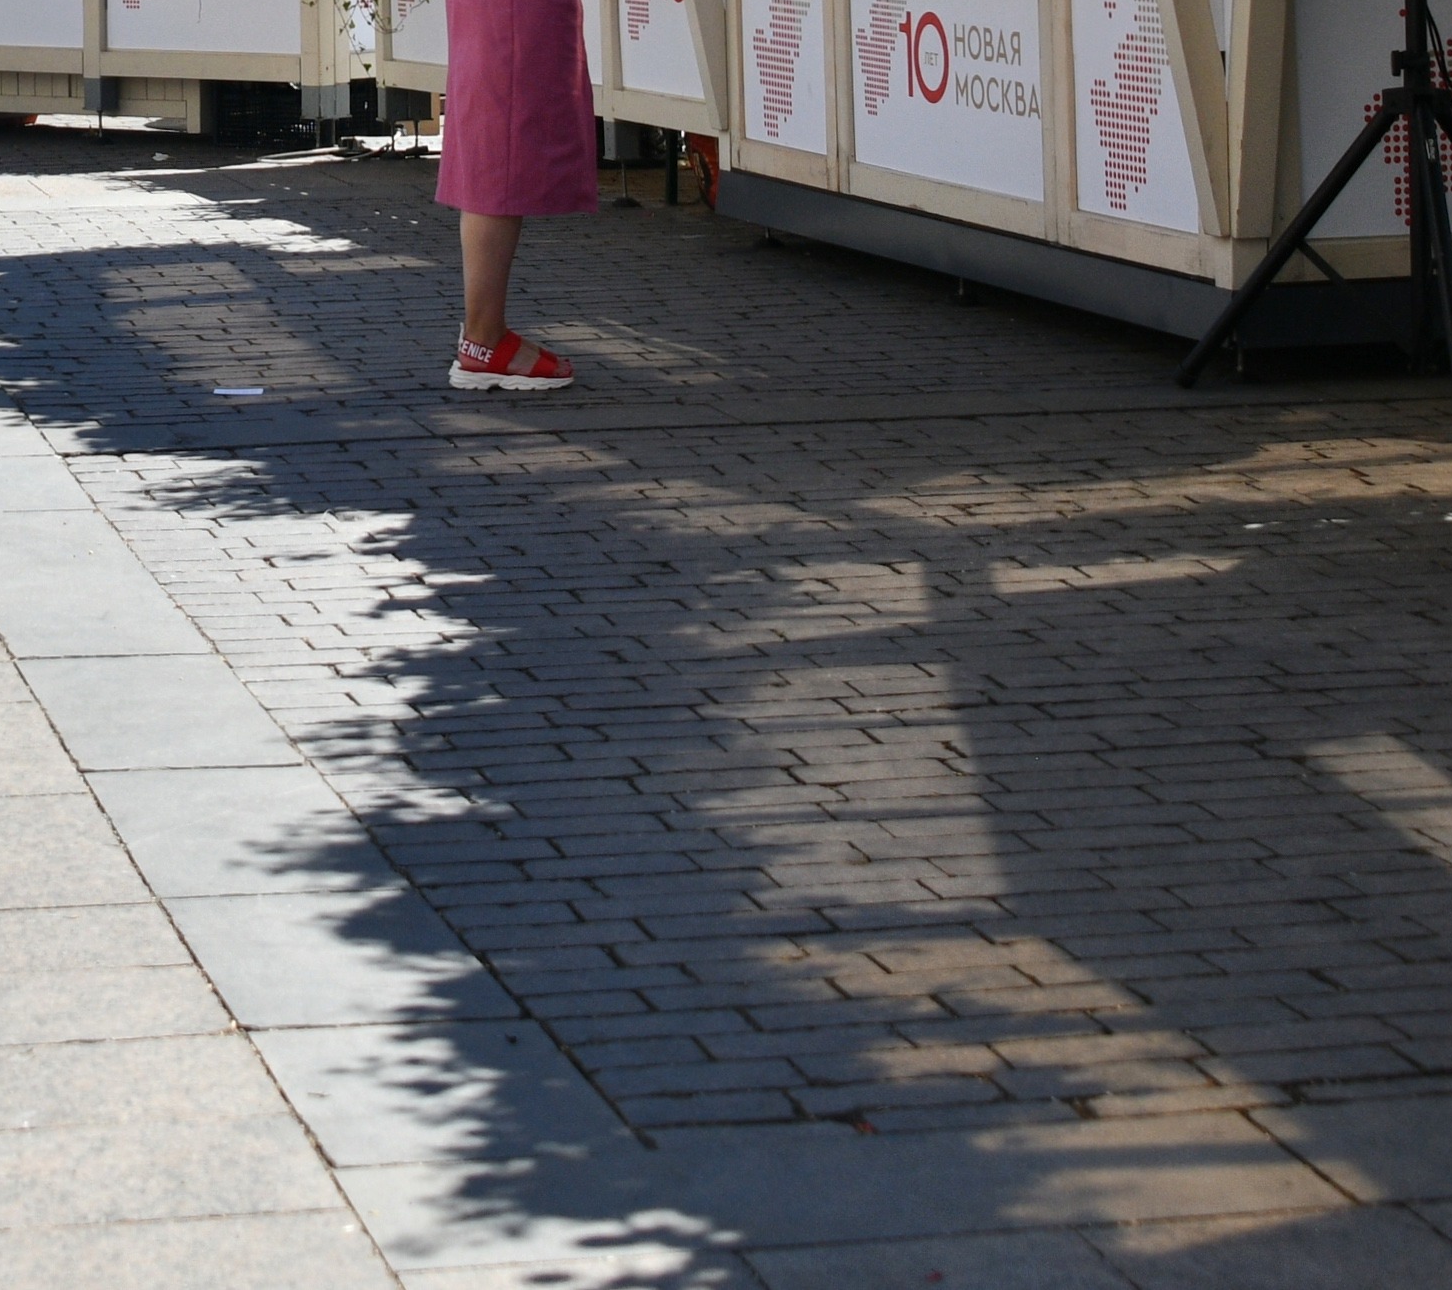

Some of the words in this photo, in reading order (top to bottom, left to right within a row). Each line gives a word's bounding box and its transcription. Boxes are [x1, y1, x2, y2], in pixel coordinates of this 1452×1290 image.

[899, 11, 949, 103] 10
[954, 24, 1021, 66] НОВАЯ
[924, 51, 939, 66] ЛЕТ
[956, 72, 1041, 120] МОСКВА
